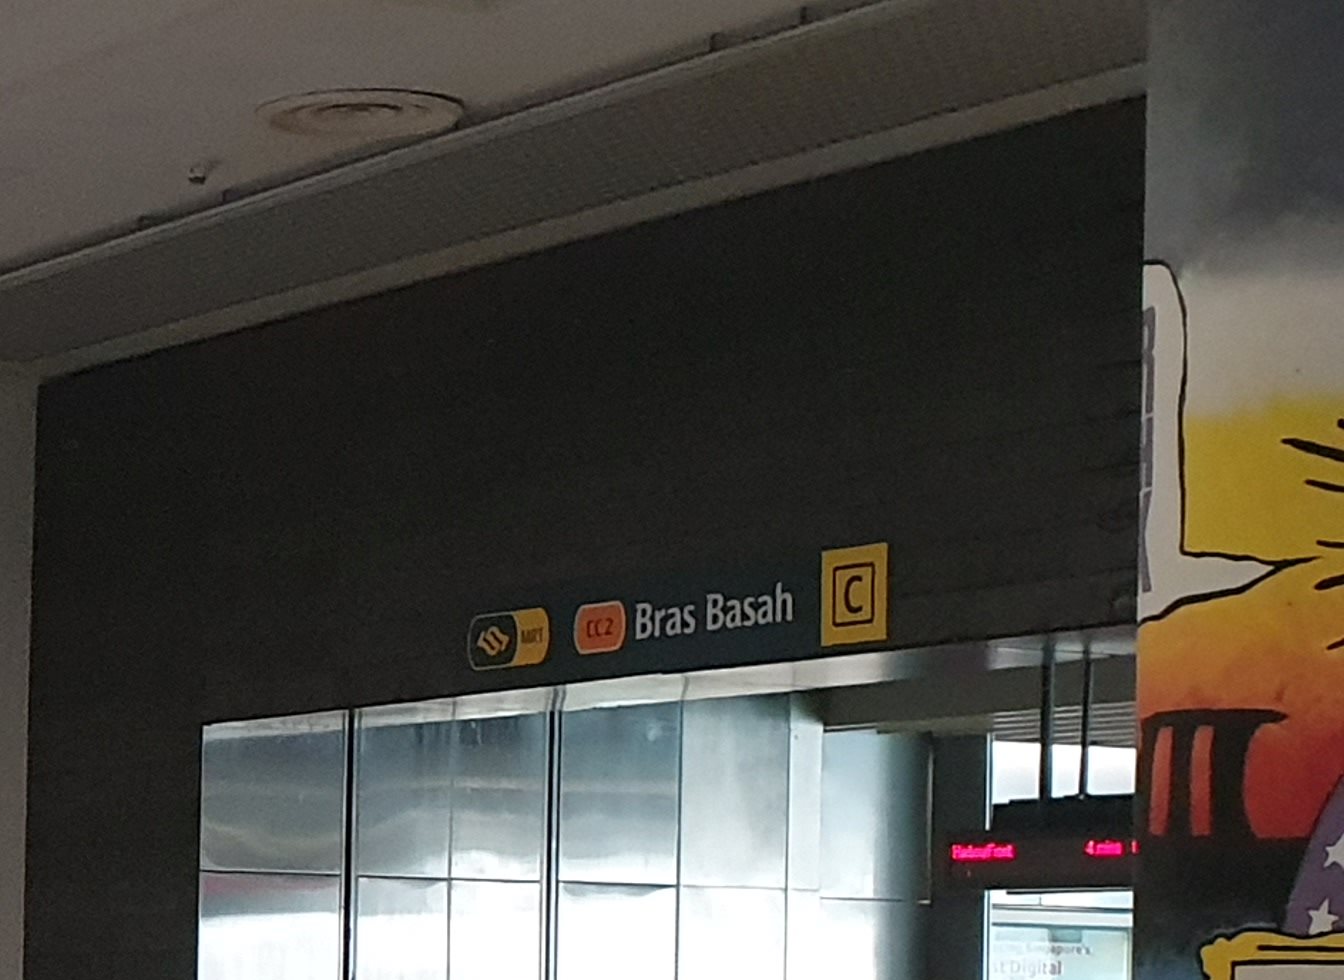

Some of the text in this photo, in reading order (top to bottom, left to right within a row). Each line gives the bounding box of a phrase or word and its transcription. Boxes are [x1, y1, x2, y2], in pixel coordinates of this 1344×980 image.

[635, 582, 793, 640] Bras Basah
[844, 575, 863, 614] C
[586, 619, 613, 639] CC2
